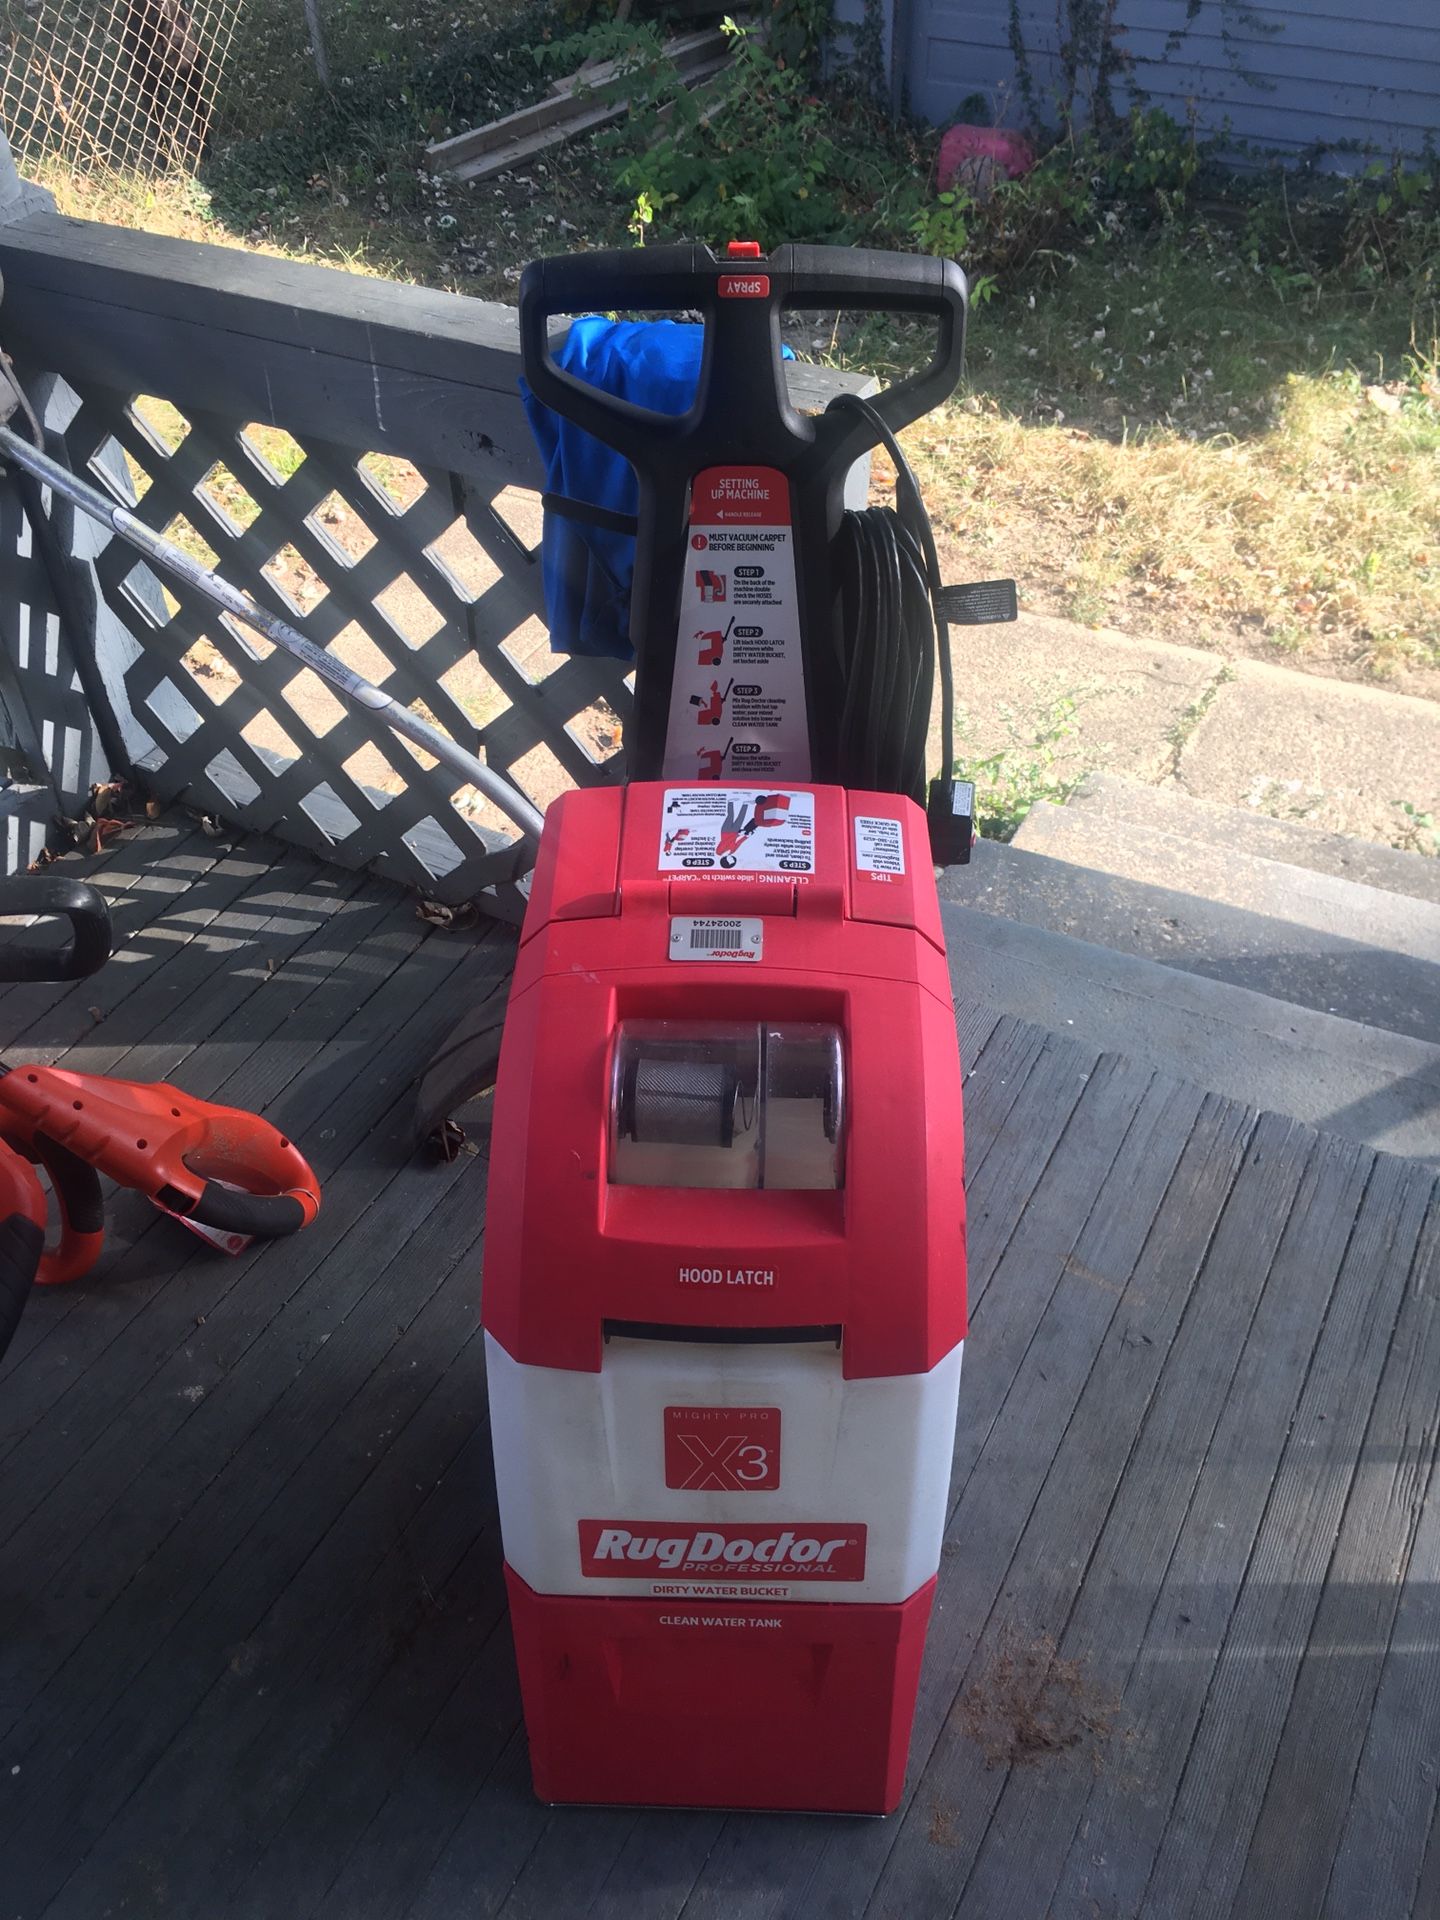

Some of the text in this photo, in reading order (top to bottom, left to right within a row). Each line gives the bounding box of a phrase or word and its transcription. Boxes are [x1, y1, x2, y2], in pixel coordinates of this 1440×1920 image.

[727, 281, 761, 293] SPRAY
[719, 479, 759, 489] SETTING
[711, 489, 770, 500] UP MACHINE
[709, 533, 786, 542] MUST VACUUM CARPET
[708, 543, 775, 551] BEFORE BEGINNING
[738, 568, 760, 576] STEP 1
[737, 628, 760, 636] STEP 2
[736, 687, 753, 695] STEP
[711, 874, 736, 882] switch
[759, 874, 809, 885] CLEANING
[870, 872, 892, 882] TIPS
[693, 920, 742, 928] 20024744
[711, 950, 755, 959] RugDoctor
[679, 1267, 774, 1286] HOOD LATCH
[672, 1411, 769, 1421] MIGHTY PRO
[677, 1434, 769, 1491] X3
[682, 1562, 837, 1574] PROFESSIONAL
[653, 1585, 789, 1597] DIRTY WATER BUCKET
[659, 1615, 783, 1628] CLEAN WATER TANK
